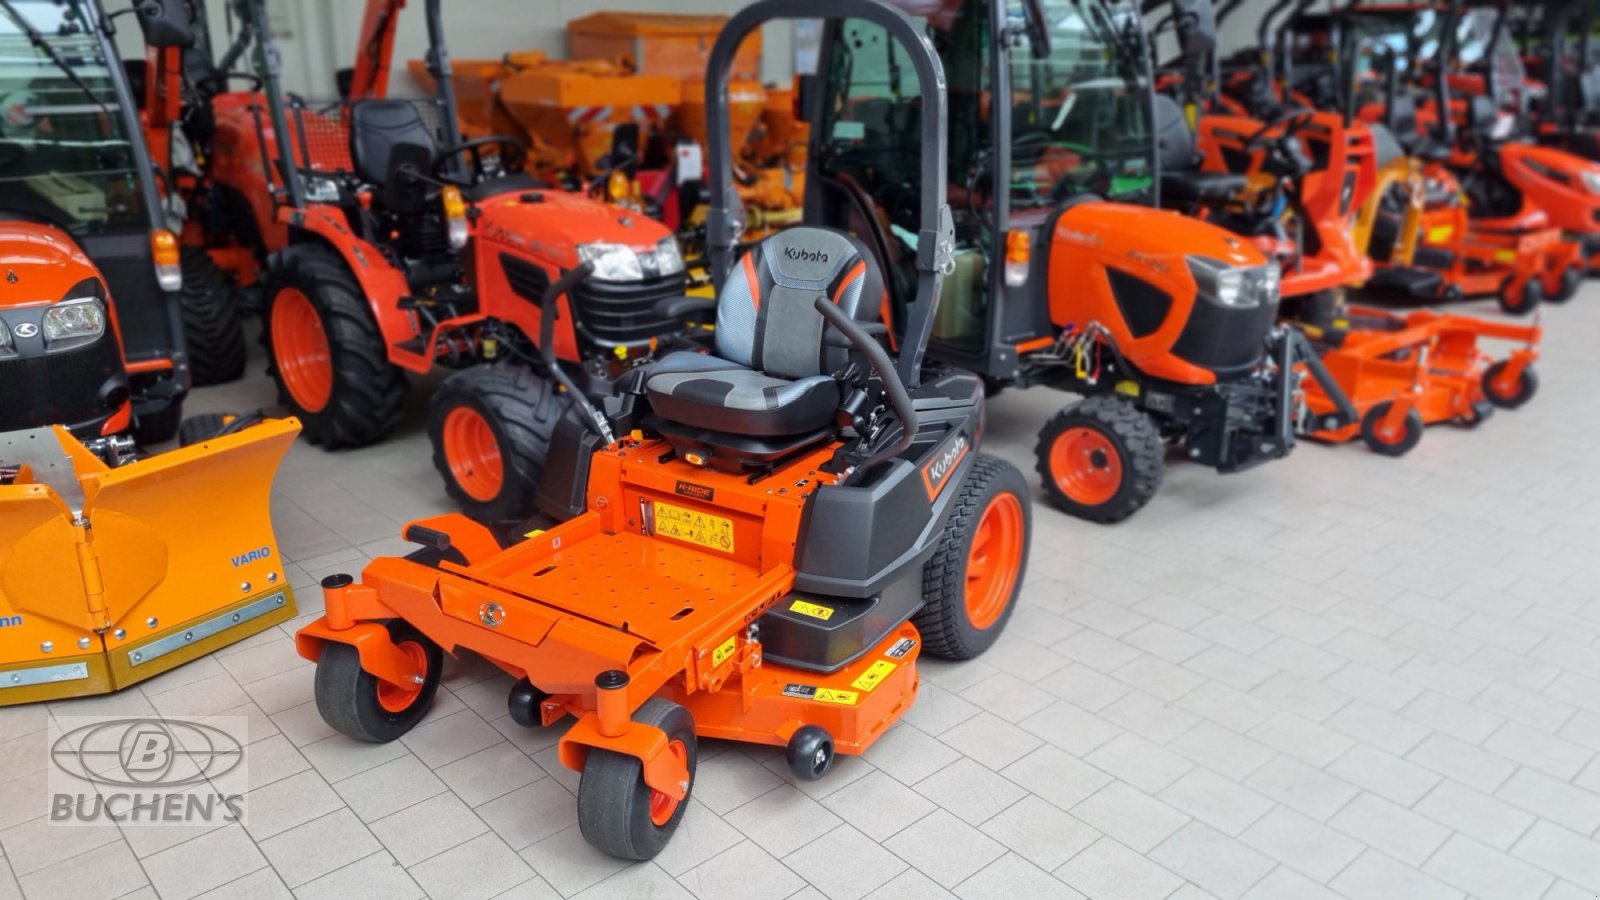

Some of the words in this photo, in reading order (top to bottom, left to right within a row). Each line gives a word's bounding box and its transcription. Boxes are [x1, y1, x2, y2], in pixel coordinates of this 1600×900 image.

[784, 246, 828, 263] Kubota
[931, 437, 965, 479] Kubota
[679, 483, 711, 496] K-RIDE
[231, 546, 270, 567] VARIO
